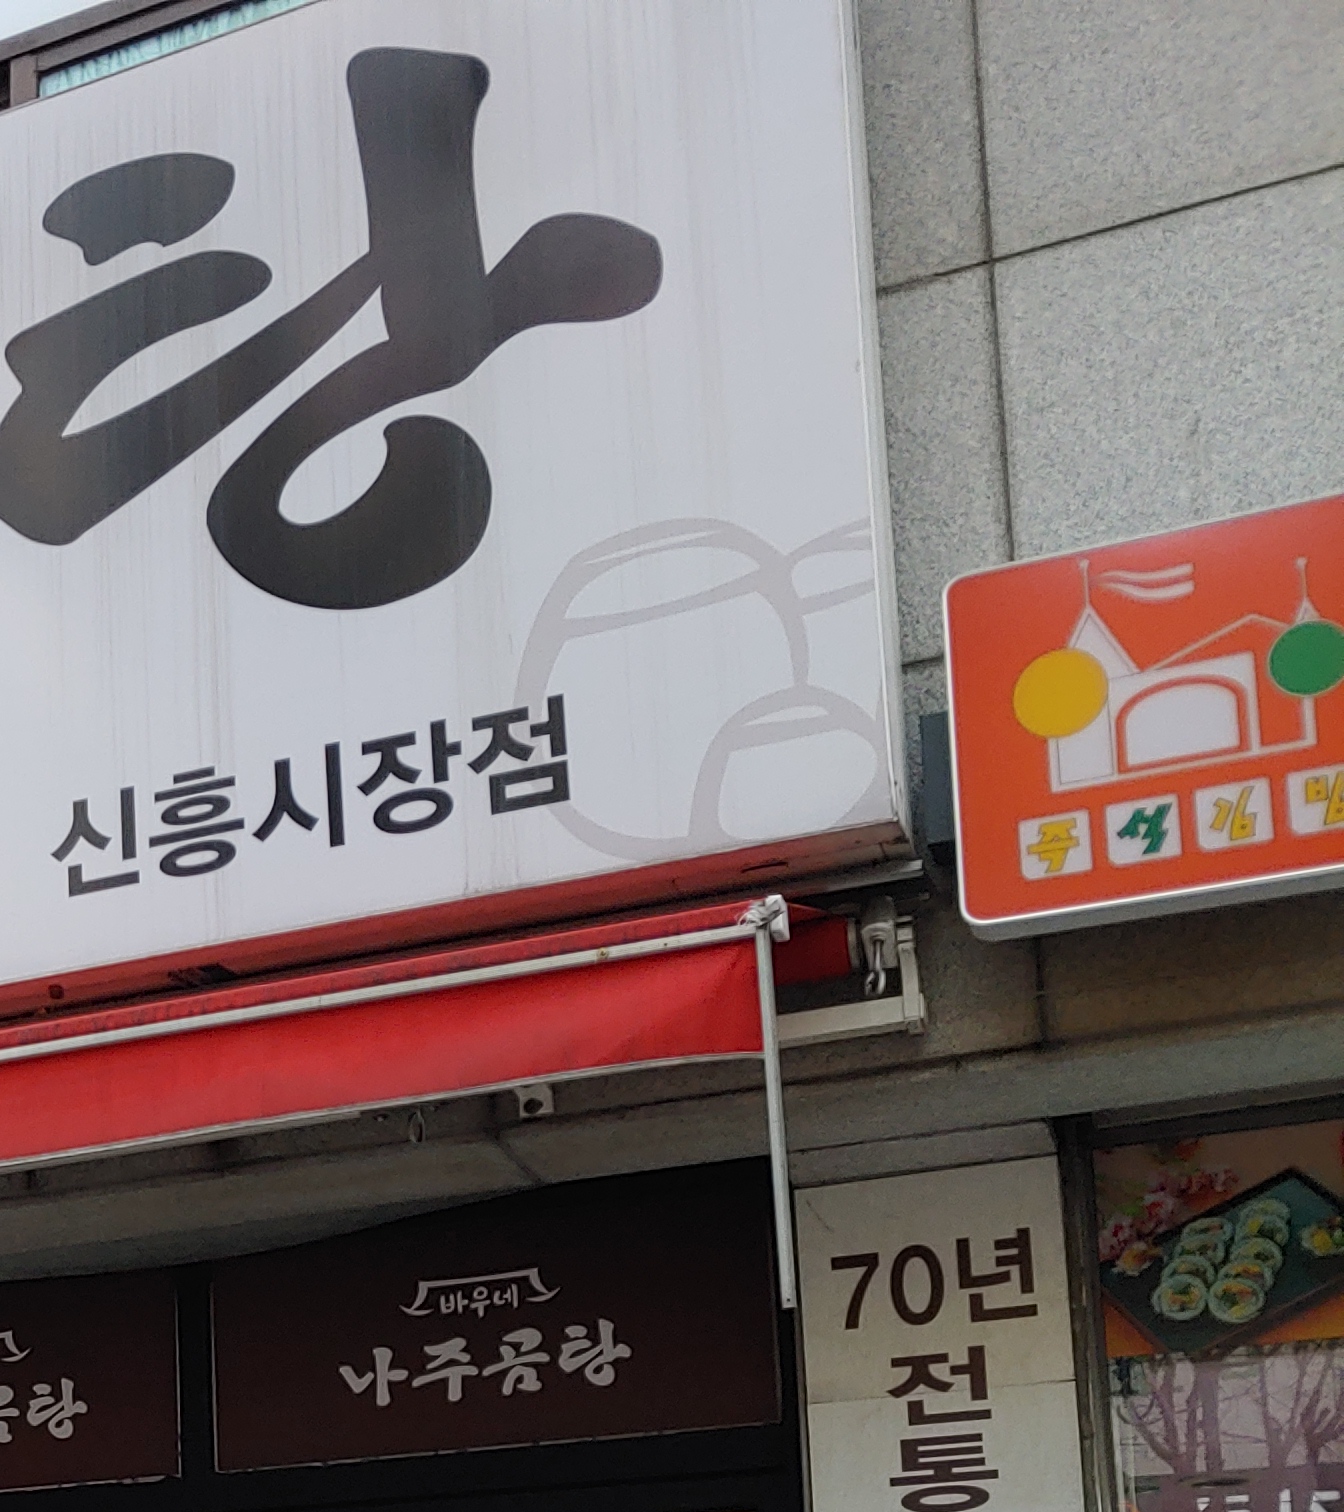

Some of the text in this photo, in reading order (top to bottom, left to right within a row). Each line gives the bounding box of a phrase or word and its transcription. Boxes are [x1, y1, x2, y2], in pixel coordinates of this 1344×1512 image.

[49, 693, 574, 898] 신흥시장점
[439, 1285, 521, 1319] 바우네
[829, 1225, 1041, 1332] 70년
[338, 1317, 633, 1408] 나주곰탕
